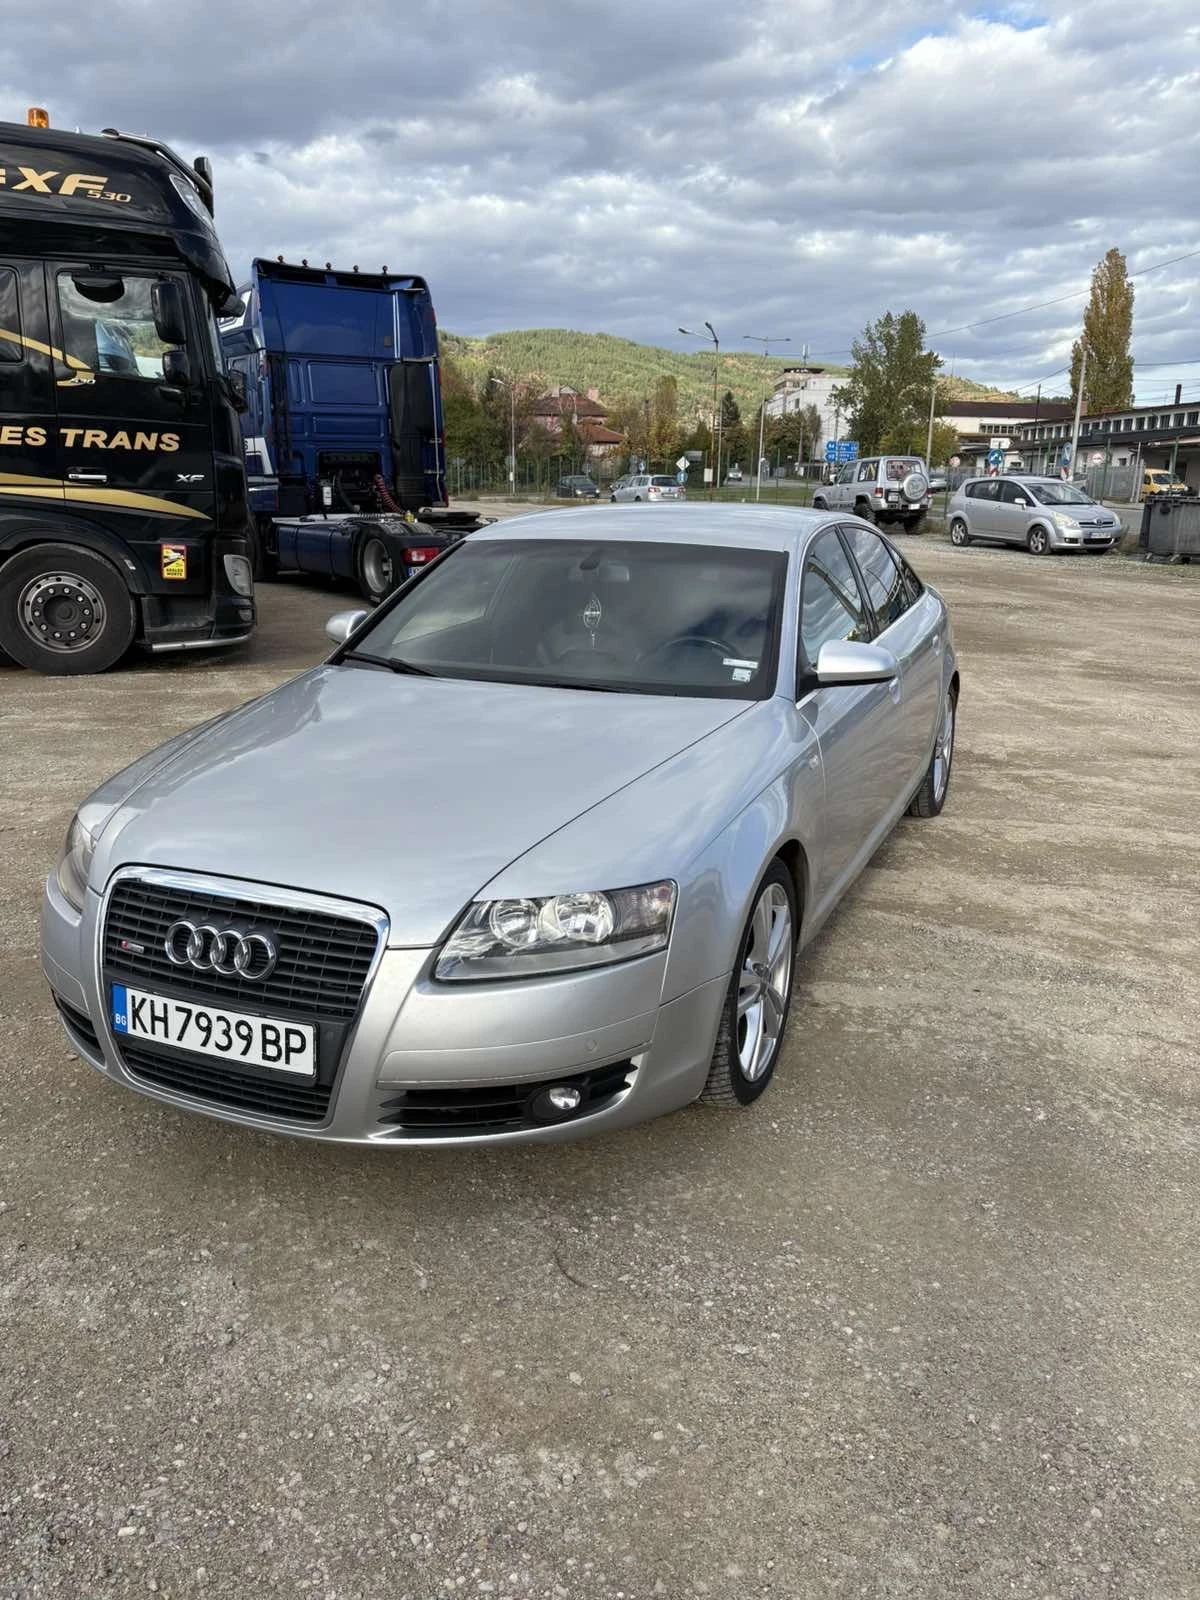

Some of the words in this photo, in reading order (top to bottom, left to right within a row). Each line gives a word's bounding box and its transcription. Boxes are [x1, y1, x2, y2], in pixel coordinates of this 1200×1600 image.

[11, 166, 108, 195] XF
[86, 189, 132, 203] 530
[60, 428, 180, 452] TRANS
[176, 473, 205, 483] XF
[115, 1013, 127, 1026] BG
[131, 995, 307, 1065] KH7939BP
